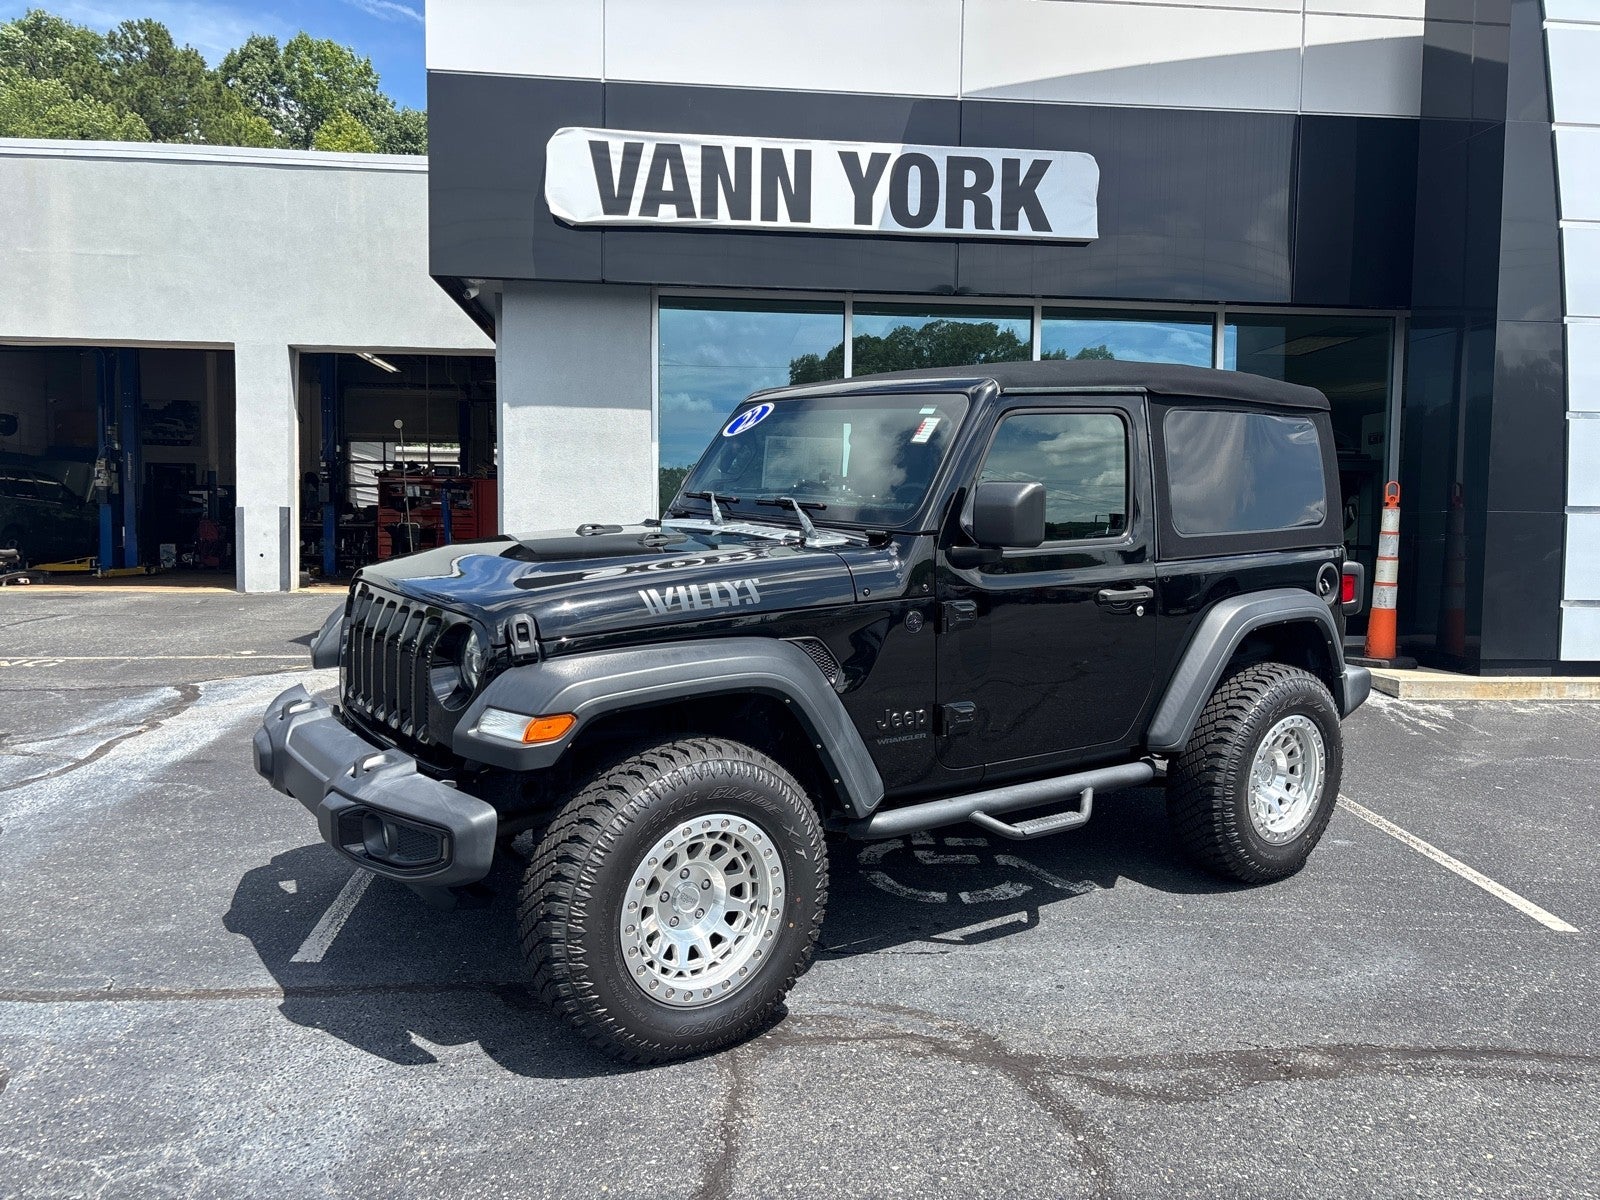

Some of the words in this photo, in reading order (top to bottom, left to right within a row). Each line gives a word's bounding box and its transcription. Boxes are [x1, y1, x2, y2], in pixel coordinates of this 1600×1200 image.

[588, 140, 812, 224] VANN
[838, 150, 1053, 232] YORK
[638, 578, 760, 615] WILLYS
[876, 708, 928, 730] Jeep
[876, 732, 928, 746] WRANGLER
